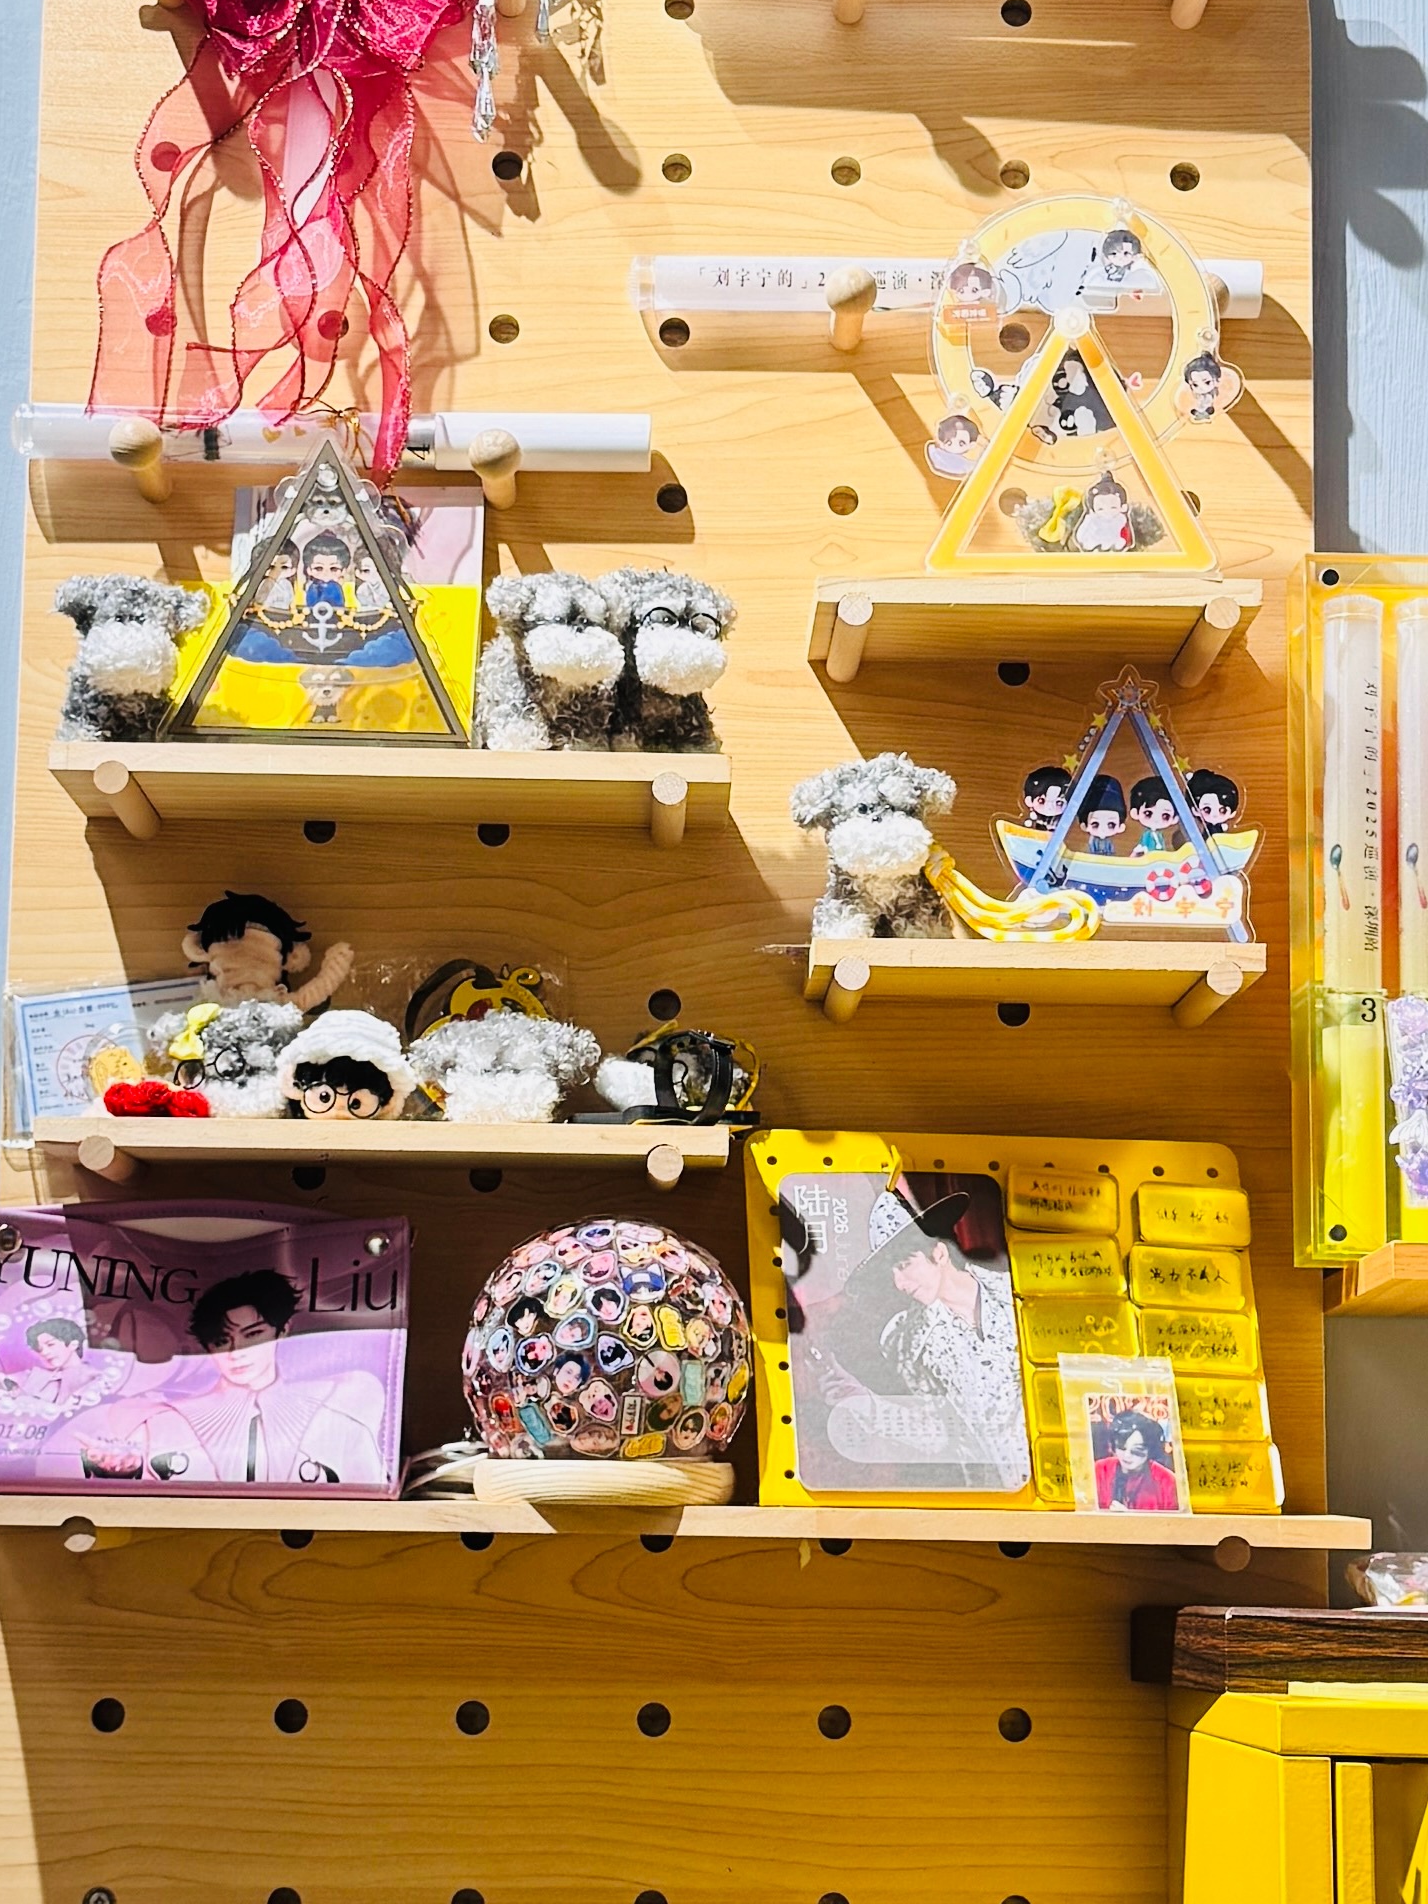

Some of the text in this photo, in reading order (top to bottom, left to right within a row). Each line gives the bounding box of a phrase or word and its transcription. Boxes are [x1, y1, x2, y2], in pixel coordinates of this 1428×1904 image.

[1361, 997, 1377, 1023] 3
[832, 1197, 850, 1234] 2026
[308, 1258, 400, 1313] Liu
